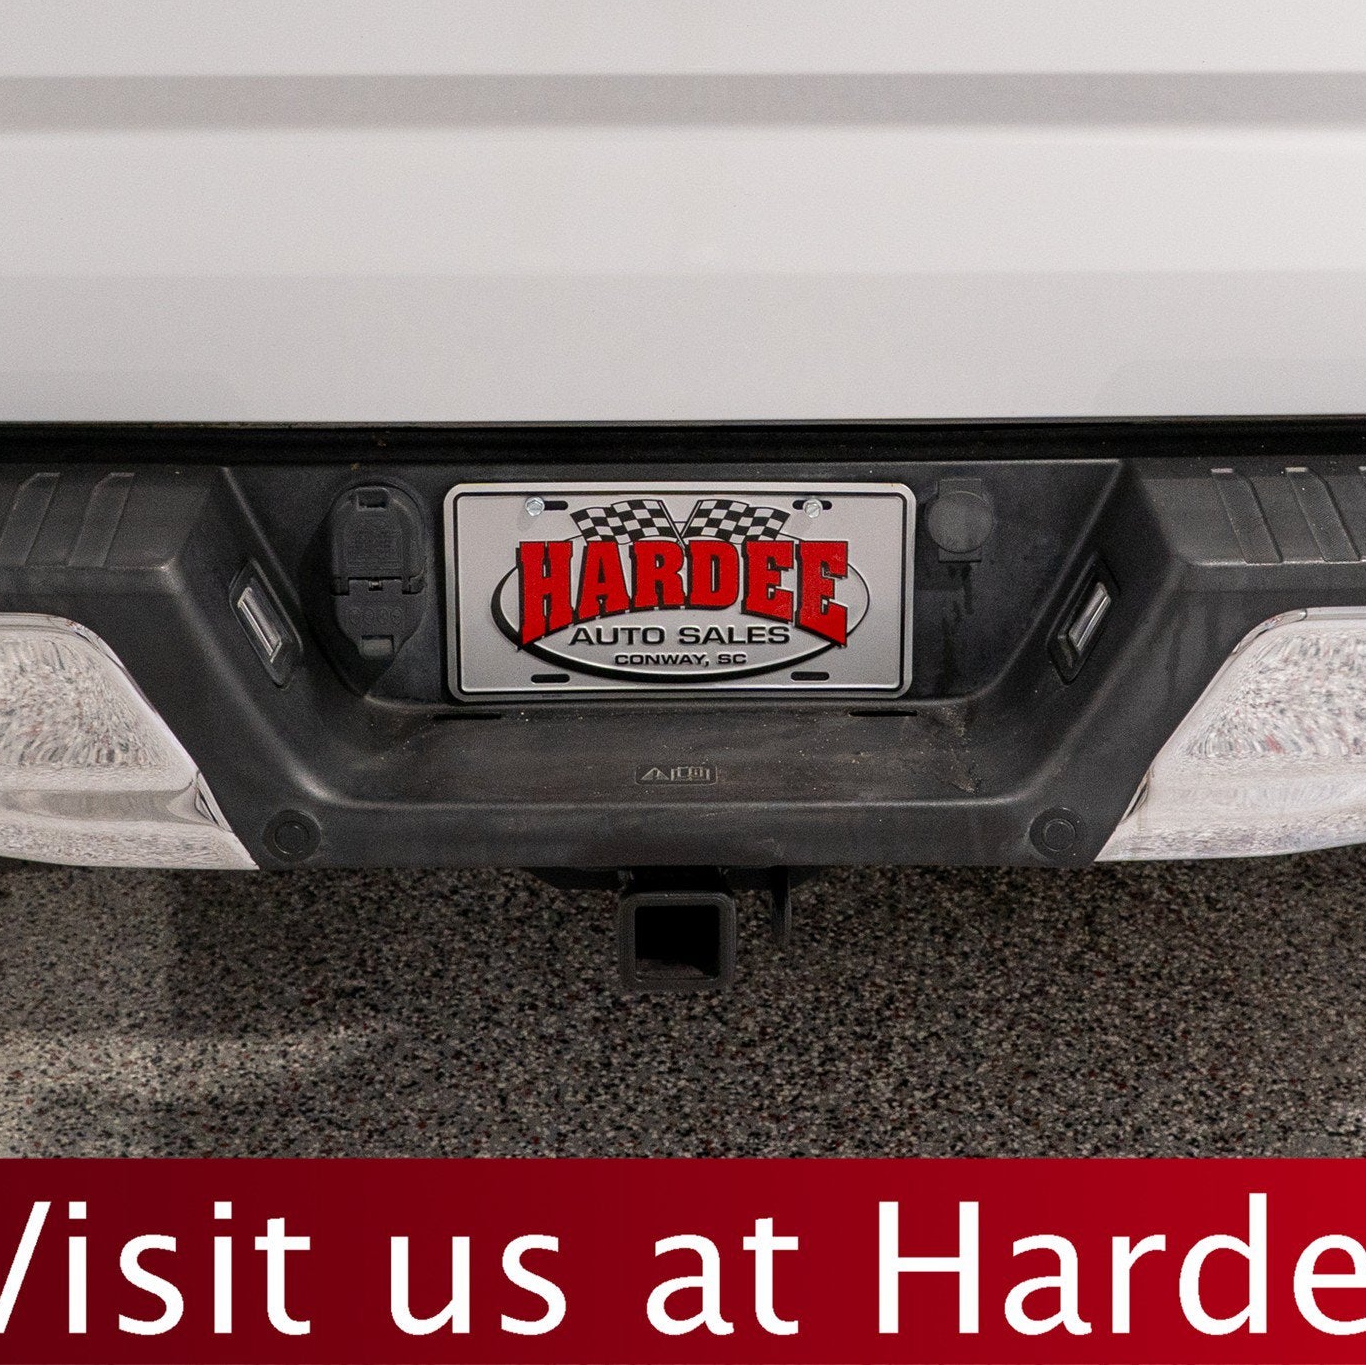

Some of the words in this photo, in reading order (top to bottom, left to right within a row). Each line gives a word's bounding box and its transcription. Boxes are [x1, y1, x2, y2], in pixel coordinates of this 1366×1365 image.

[517, 539, 849, 650] HARDEE
[569, 626, 666, 646] AUTO
[678, 625, 791, 645] SALES
[614, 653, 710, 667] CONWAY,
[717, 653, 747, 665] SC
